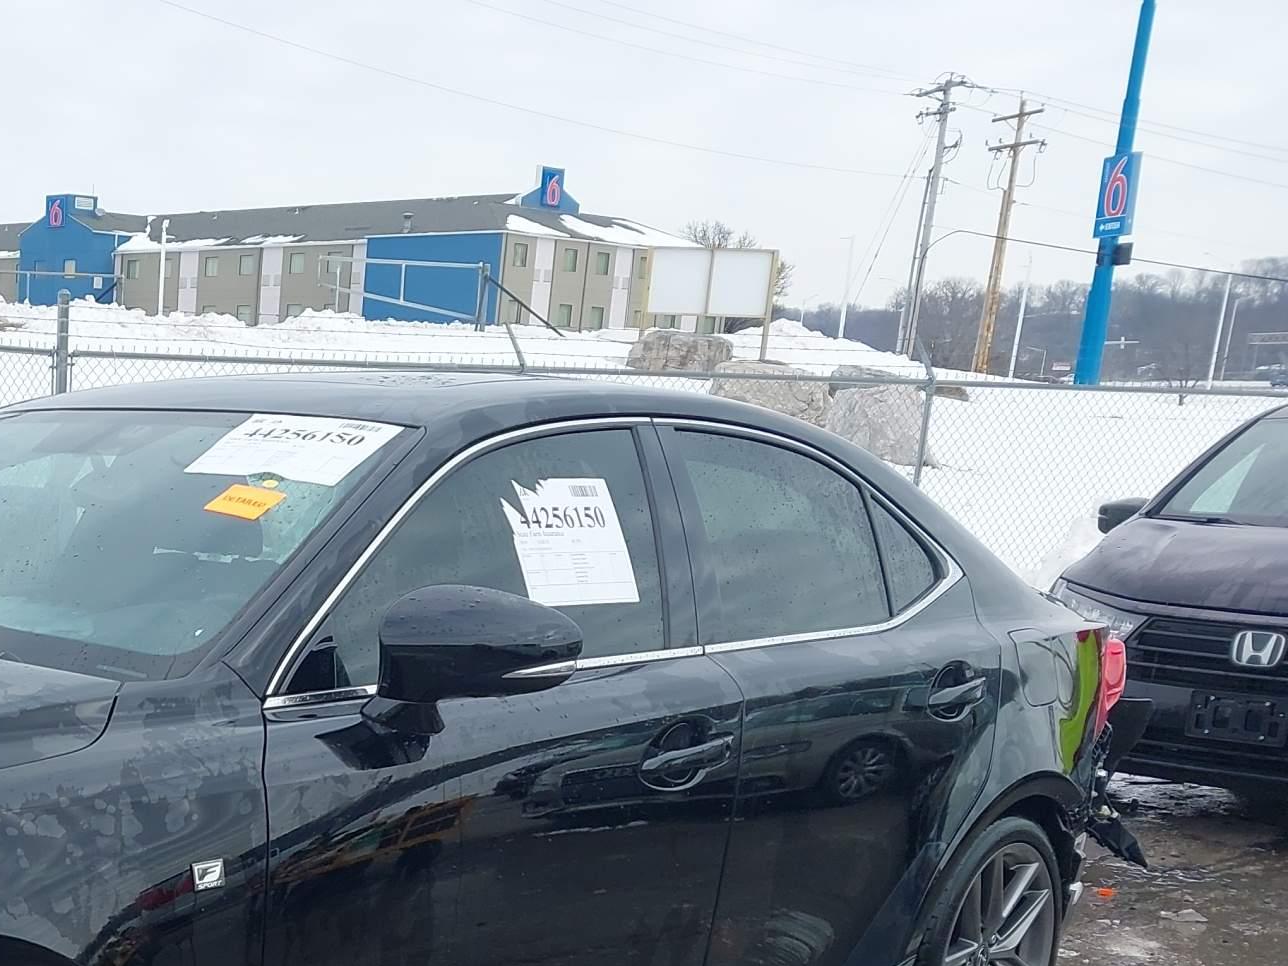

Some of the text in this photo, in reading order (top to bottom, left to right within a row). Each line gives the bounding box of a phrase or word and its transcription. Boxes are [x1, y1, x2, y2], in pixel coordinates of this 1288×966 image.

[547, 174, 561, 206] 6
[1105, 156, 1128, 217] 6
[49, 199, 63, 226] 6
[244, 427, 366, 446] 44256150
[197, 880, 222, 890] SPORT
